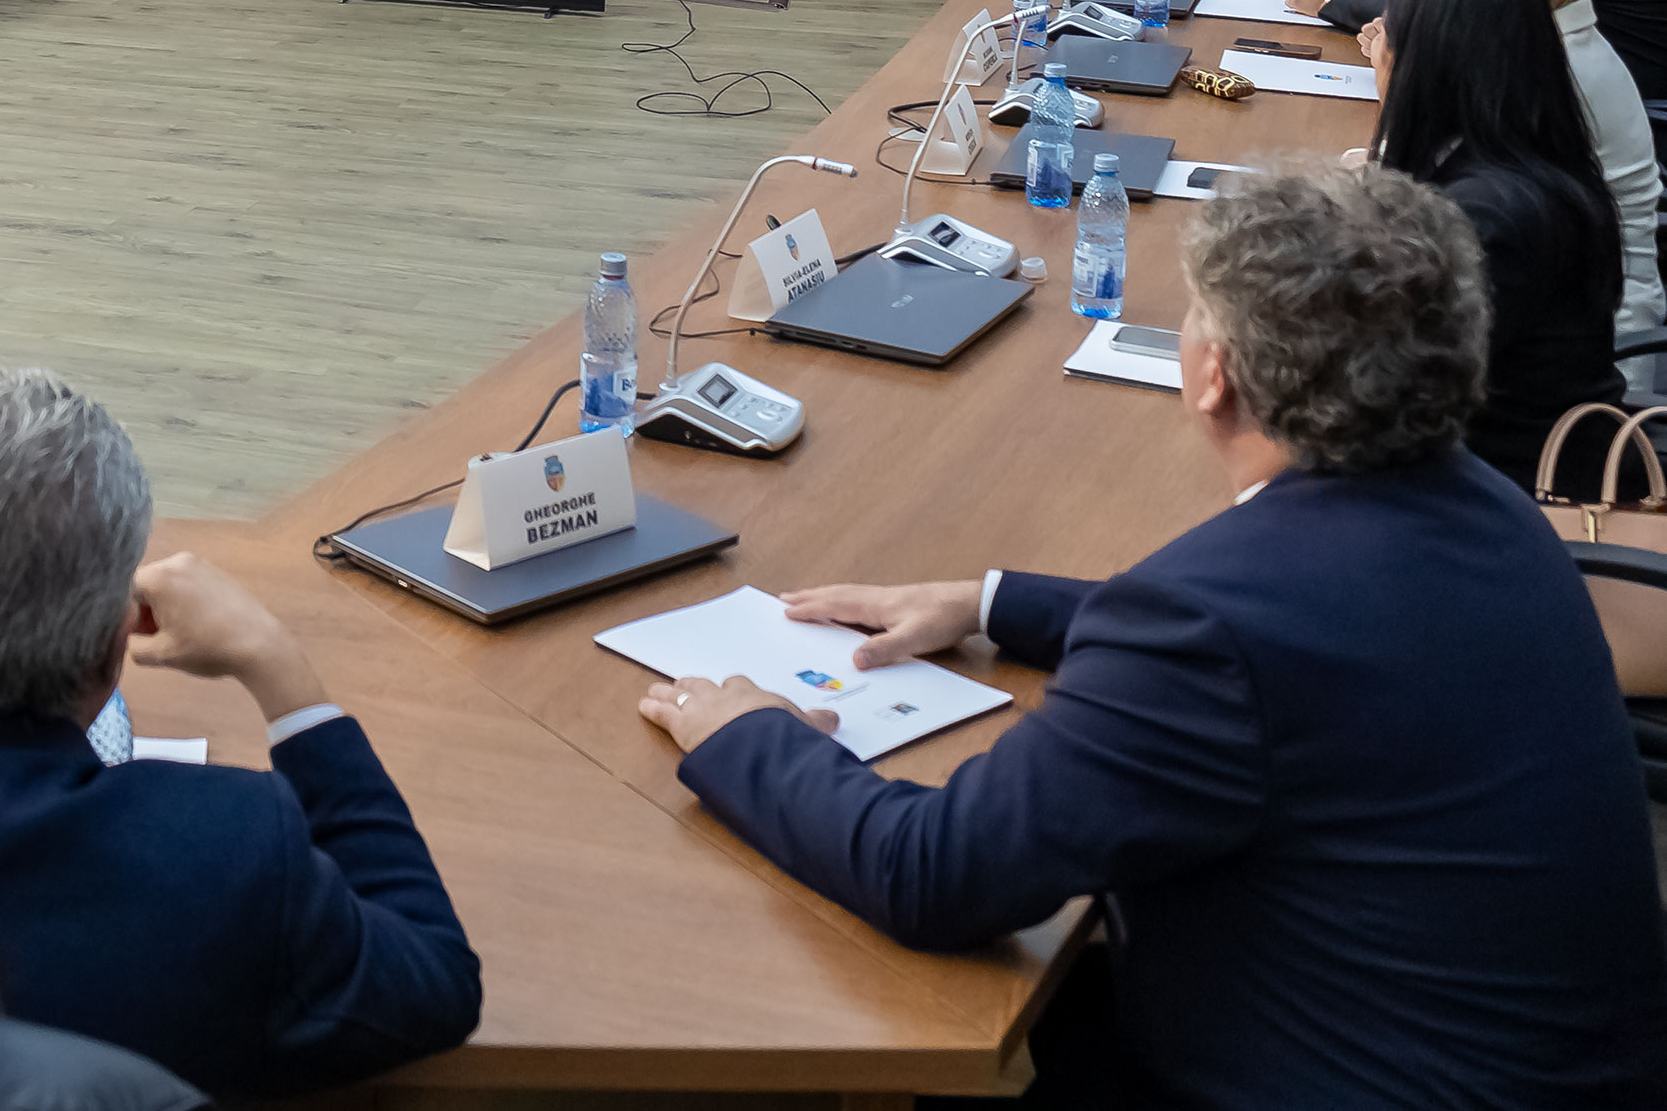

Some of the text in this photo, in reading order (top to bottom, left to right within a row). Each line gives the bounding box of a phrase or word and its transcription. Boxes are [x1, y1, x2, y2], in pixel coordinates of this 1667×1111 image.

[788, 270, 825, 303] ATANASIU
[524, 492, 596, 523] GHEORGHE
[526, 510, 598, 544] BEZMAN
